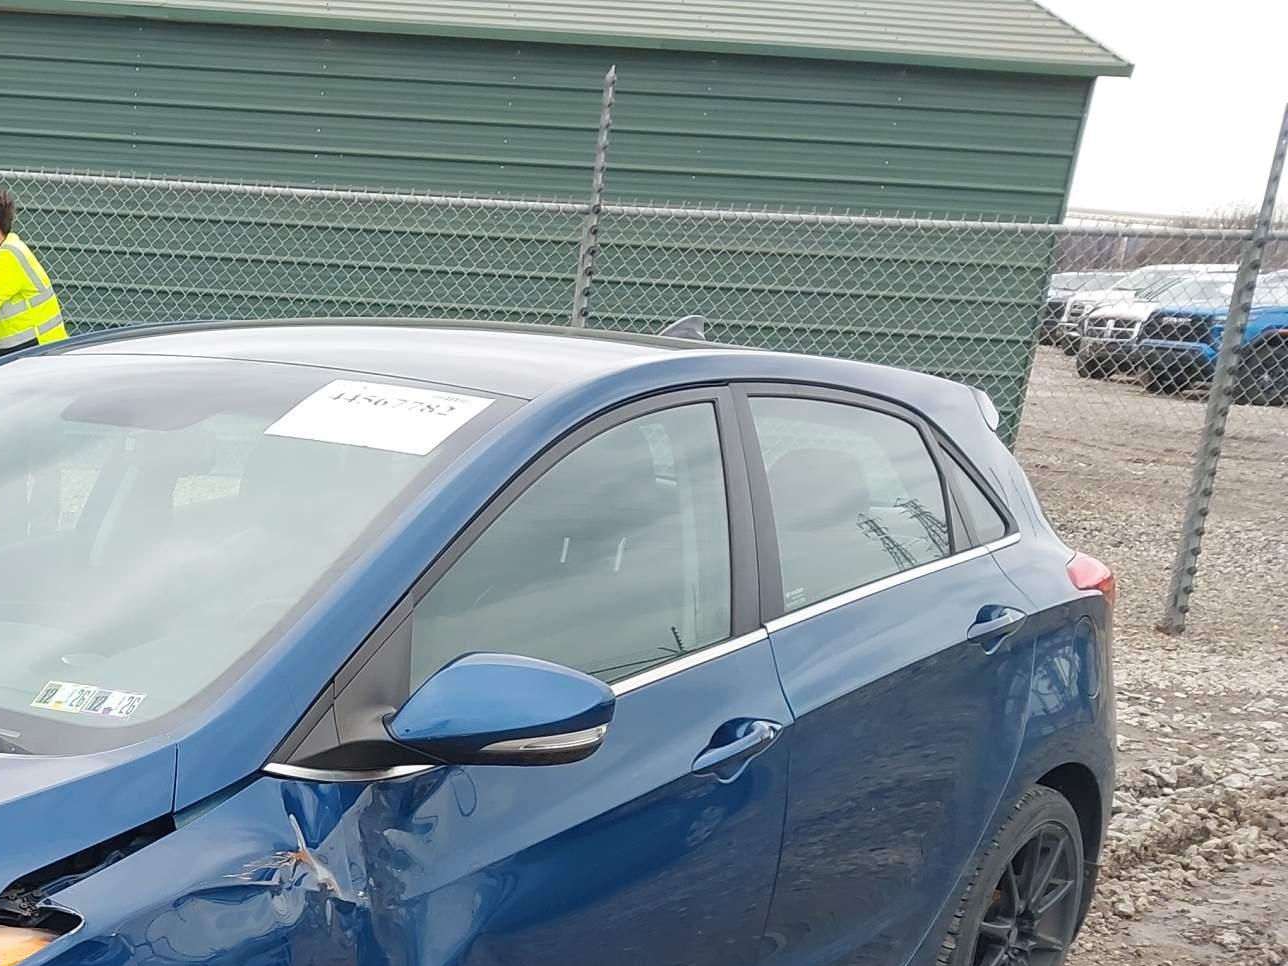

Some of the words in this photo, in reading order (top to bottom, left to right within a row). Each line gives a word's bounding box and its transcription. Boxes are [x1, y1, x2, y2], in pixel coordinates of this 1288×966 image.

[37, 688, 59, 704] 12
[69, 688, 92, 708] 26
[85, 695, 109, 712] 12
[118, 696, 141, 715] 26
